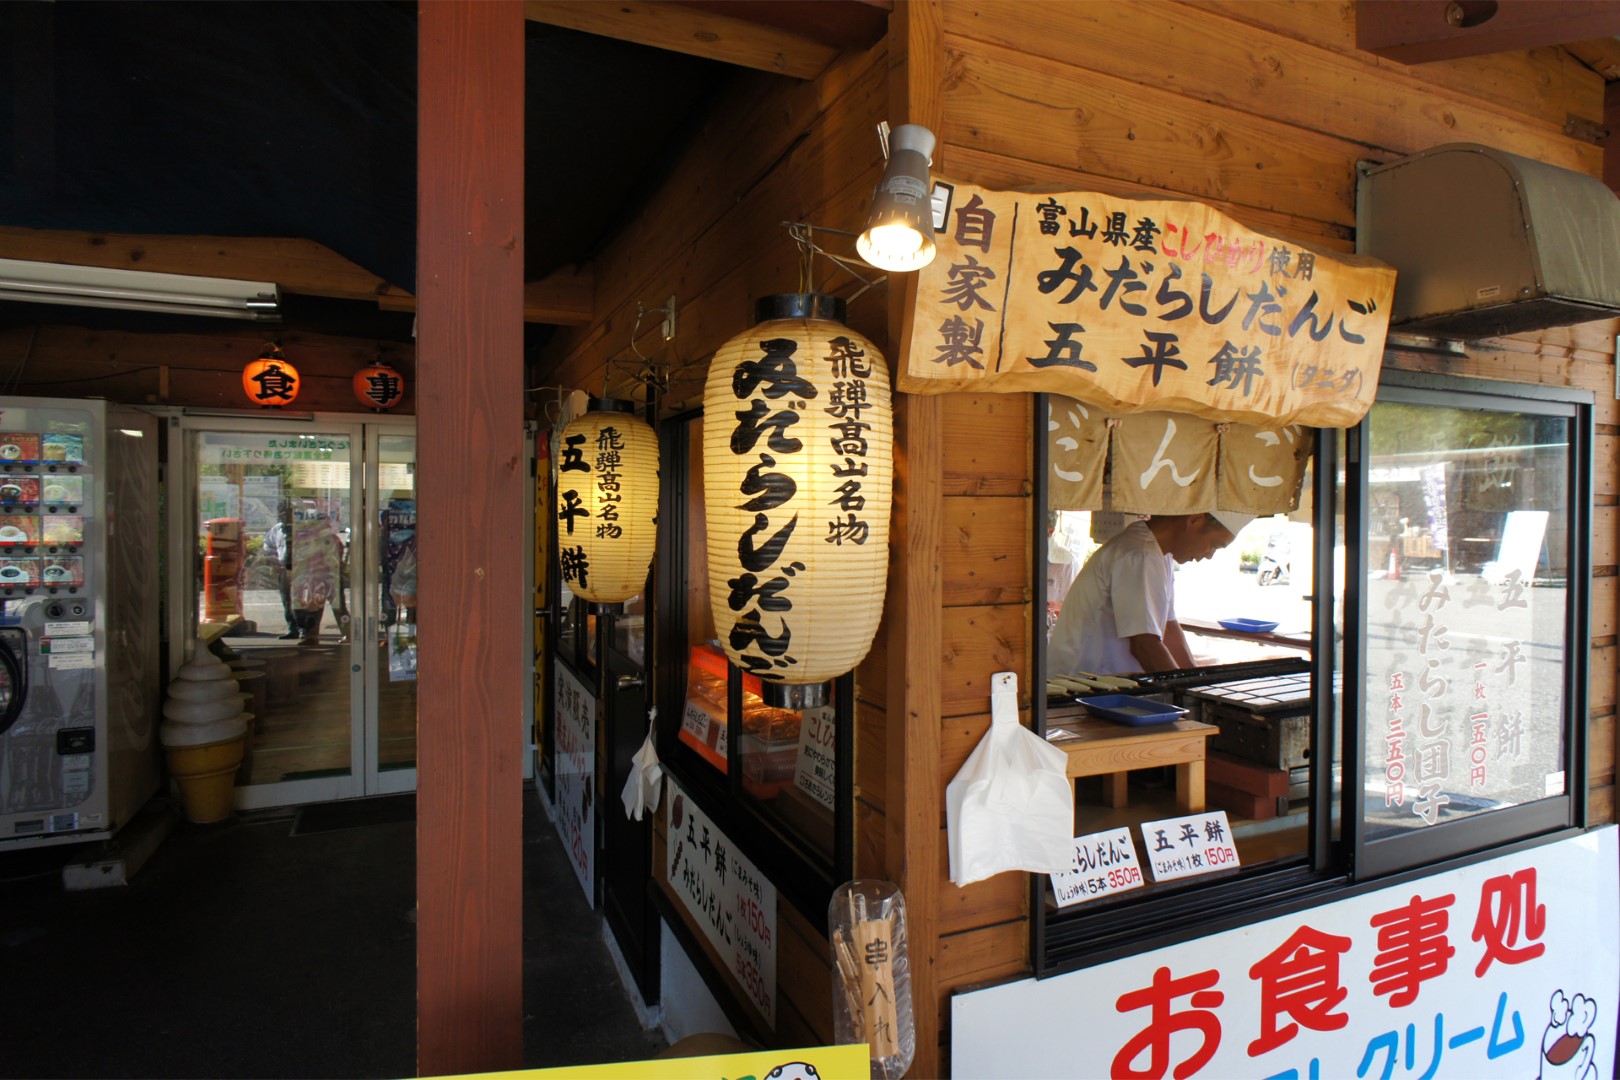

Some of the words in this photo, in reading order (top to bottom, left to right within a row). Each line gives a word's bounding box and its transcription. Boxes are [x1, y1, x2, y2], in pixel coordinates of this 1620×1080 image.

[930, 194, 997, 371] 自家製
[1037, 245, 1377, 346] みだらしだんご
[252, 364, 297, 401] 食
[364, 372, 401, 405] 事
[1026, 320, 1265, 397] 五平餅
[558, 433, 592, 590] 五平餅
[727, 338, 818, 681] みだらしだんご
[1412, 572, 1451, 826] みたらし団子
[1492, 568, 1529, 763] 五平餅
[686, 812, 728, 886] 五平餅
[1154, 819, 1225, 853] 五平餅
[865, 937, 893, 1044] 串入れ
[1110, 867, 1546, 1080] お食事処
